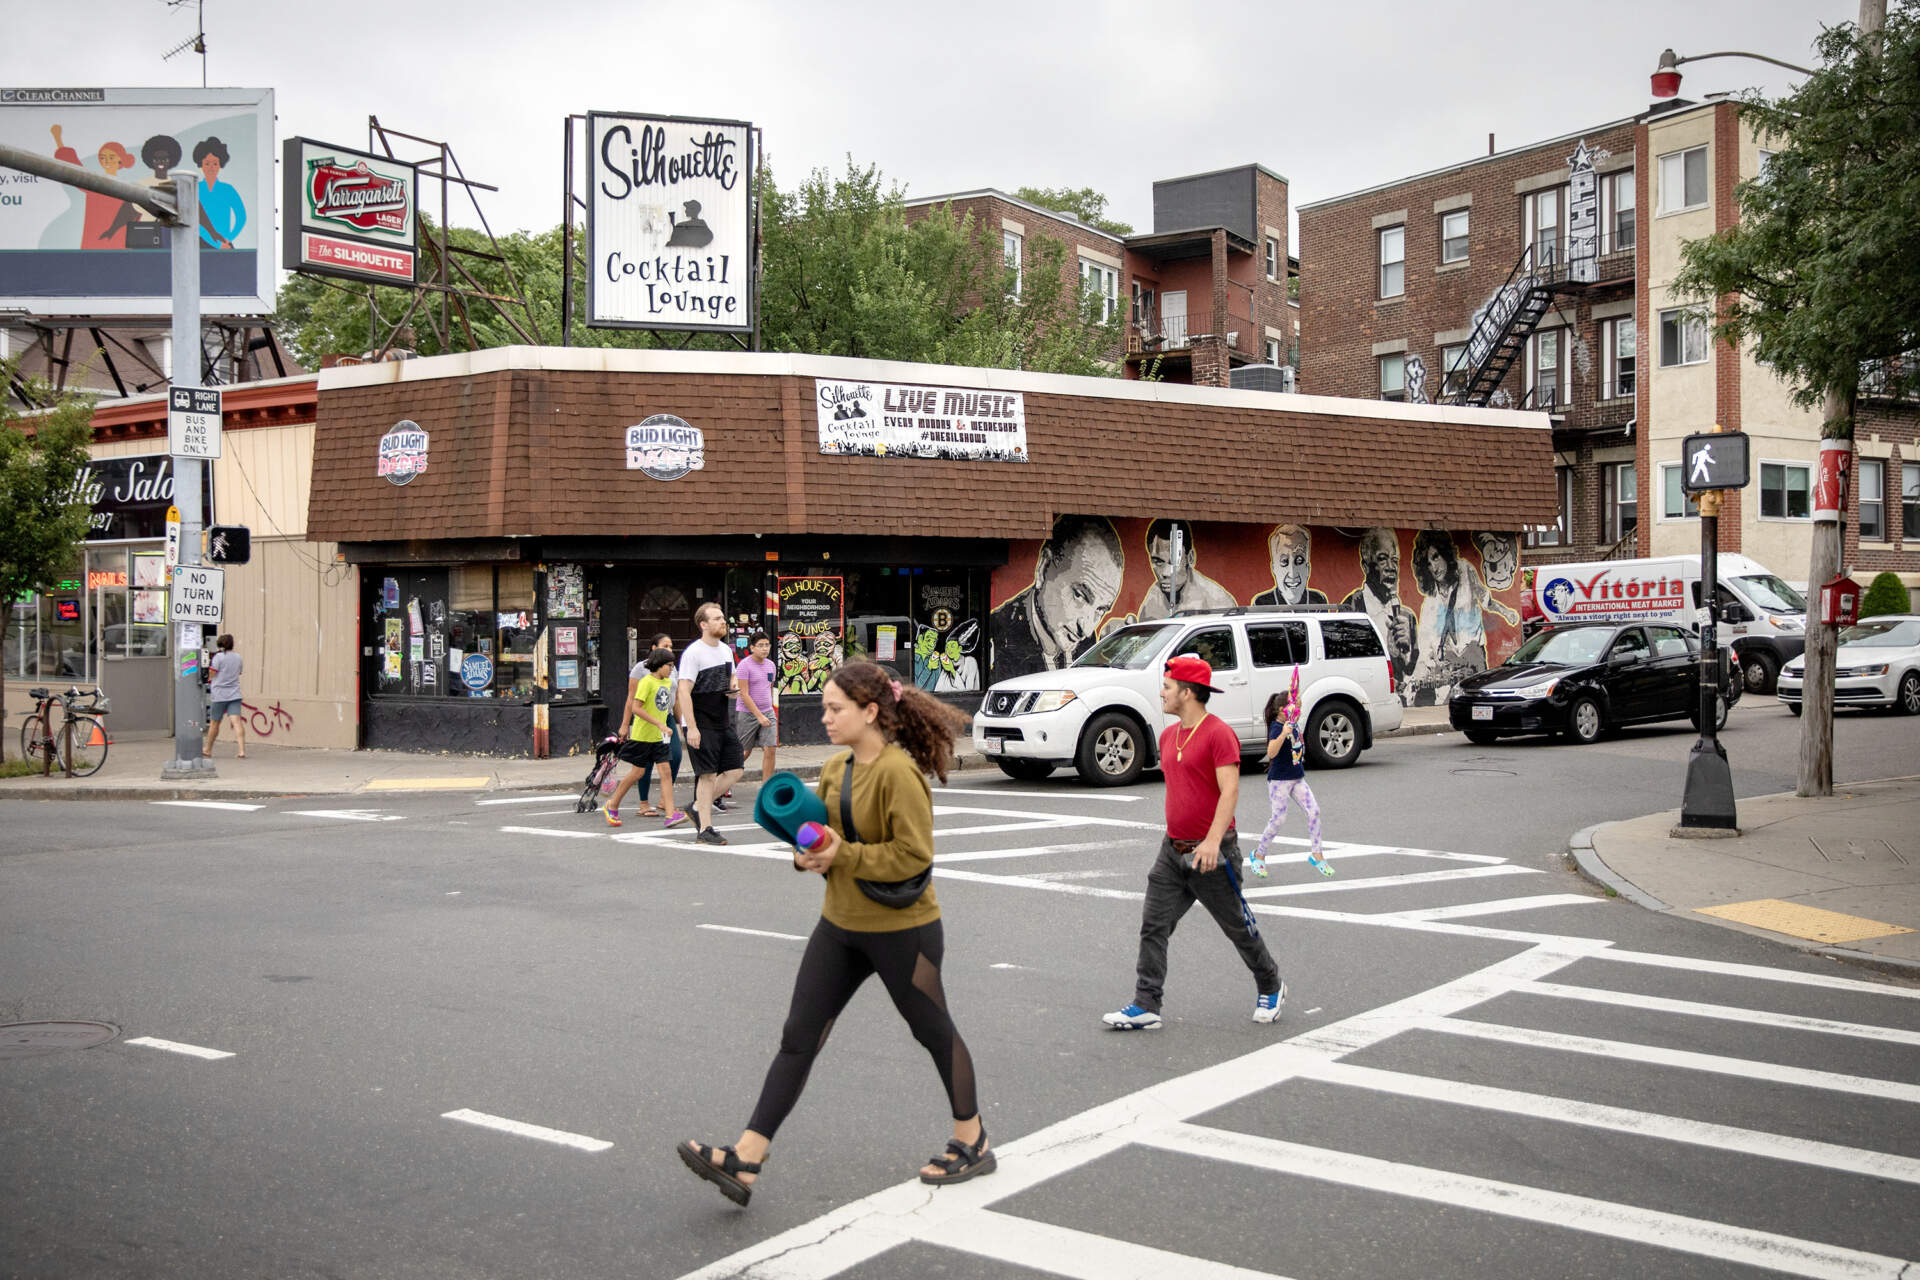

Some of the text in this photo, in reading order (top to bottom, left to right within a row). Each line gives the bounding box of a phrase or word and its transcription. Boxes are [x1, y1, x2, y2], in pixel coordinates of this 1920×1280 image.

[601, 124, 738, 200] Silhouette
[12, 172, 38, 184] visit
[316, 177, 405, 218] Narragansett
[376, 213, 402, 225] LAGER
[318, 244, 404, 270] The SILHOUETTE
[607, 251, 729, 287] Cocktail
[646, 283, 736, 319] Lounge
[195, 391, 217, 402] RIGHT
[820, 385, 873, 409] Silhouette
[883, 388, 1016, 418] LIVE MUSIC
[196, 401, 217, 412] LANE
[185, 415, 206, 425] BUS
[827, 419, 875, 433] Cocktail
[884, 416, 1017, 433] EVERY MONDAY & WEDNESDAY
[185, 426, 206, 435] AND
[631, 429, 698, 446] BUD LIGHT
[184, 434, 207, 445] BIKE
[382, 433, 425, 452] BUD LIGHT
[184, 444, 208, 455] ONLY
[379, 455, 427, 474] DARTS
[114, 460, 174, 503] Salo
[191, 573, 207, 585] NO
[1574, 568, 1684, 600] Vitória
[184, 587, 214, 601] TURN
[780, 579, 841, 601] SILHOUETTE
[175, 602, 219, 617] ON RED
[1575, 599, 1682, 612] INTERNATIONAL MEAT MARKET
[1613, 611, 1631, 620] right
[788, 619, 832, 636] LOUNGE
